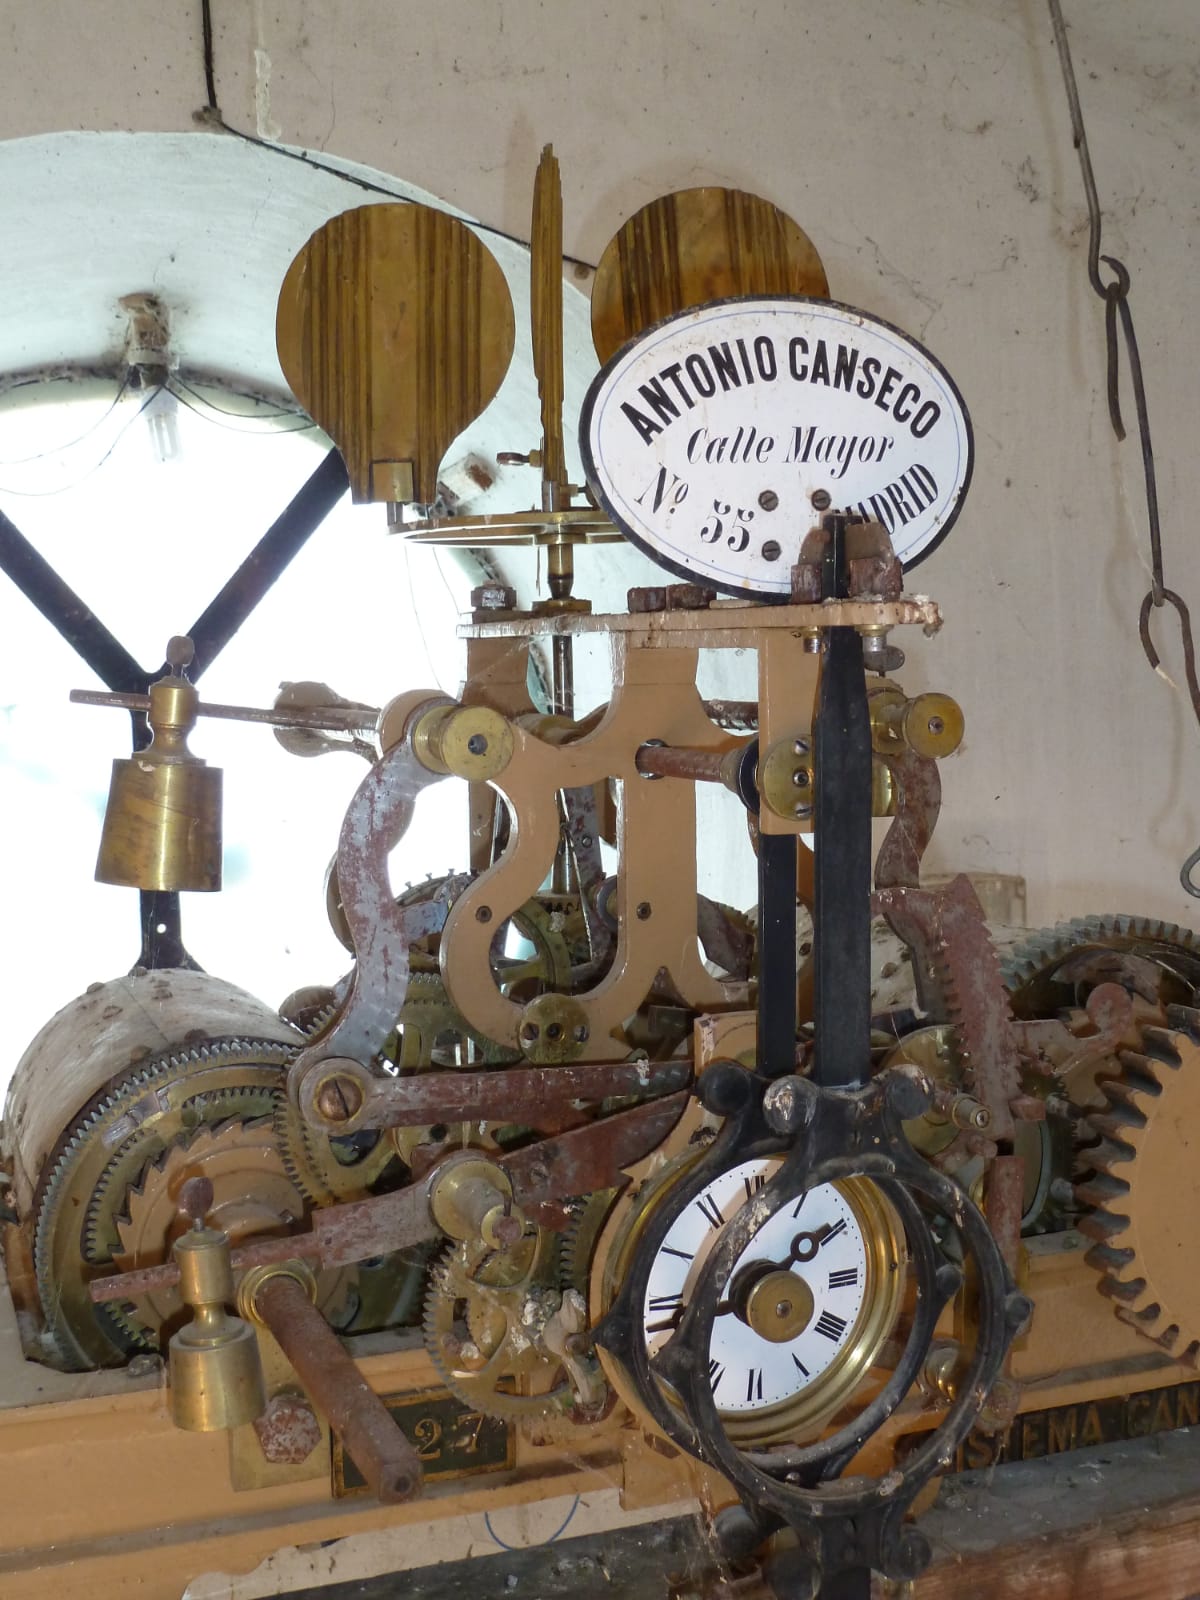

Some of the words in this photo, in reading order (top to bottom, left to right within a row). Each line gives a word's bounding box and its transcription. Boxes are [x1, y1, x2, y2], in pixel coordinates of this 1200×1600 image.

[620, 335, 777, 446] ANTONIO
[788, 336, 941, 439] CANSECO
[687, 426, 774, 465] Calle
[782, 425, 895, 480] Mayor
[700, 499, 755, 553] 55
[831, 463, 938, 535] DRID
